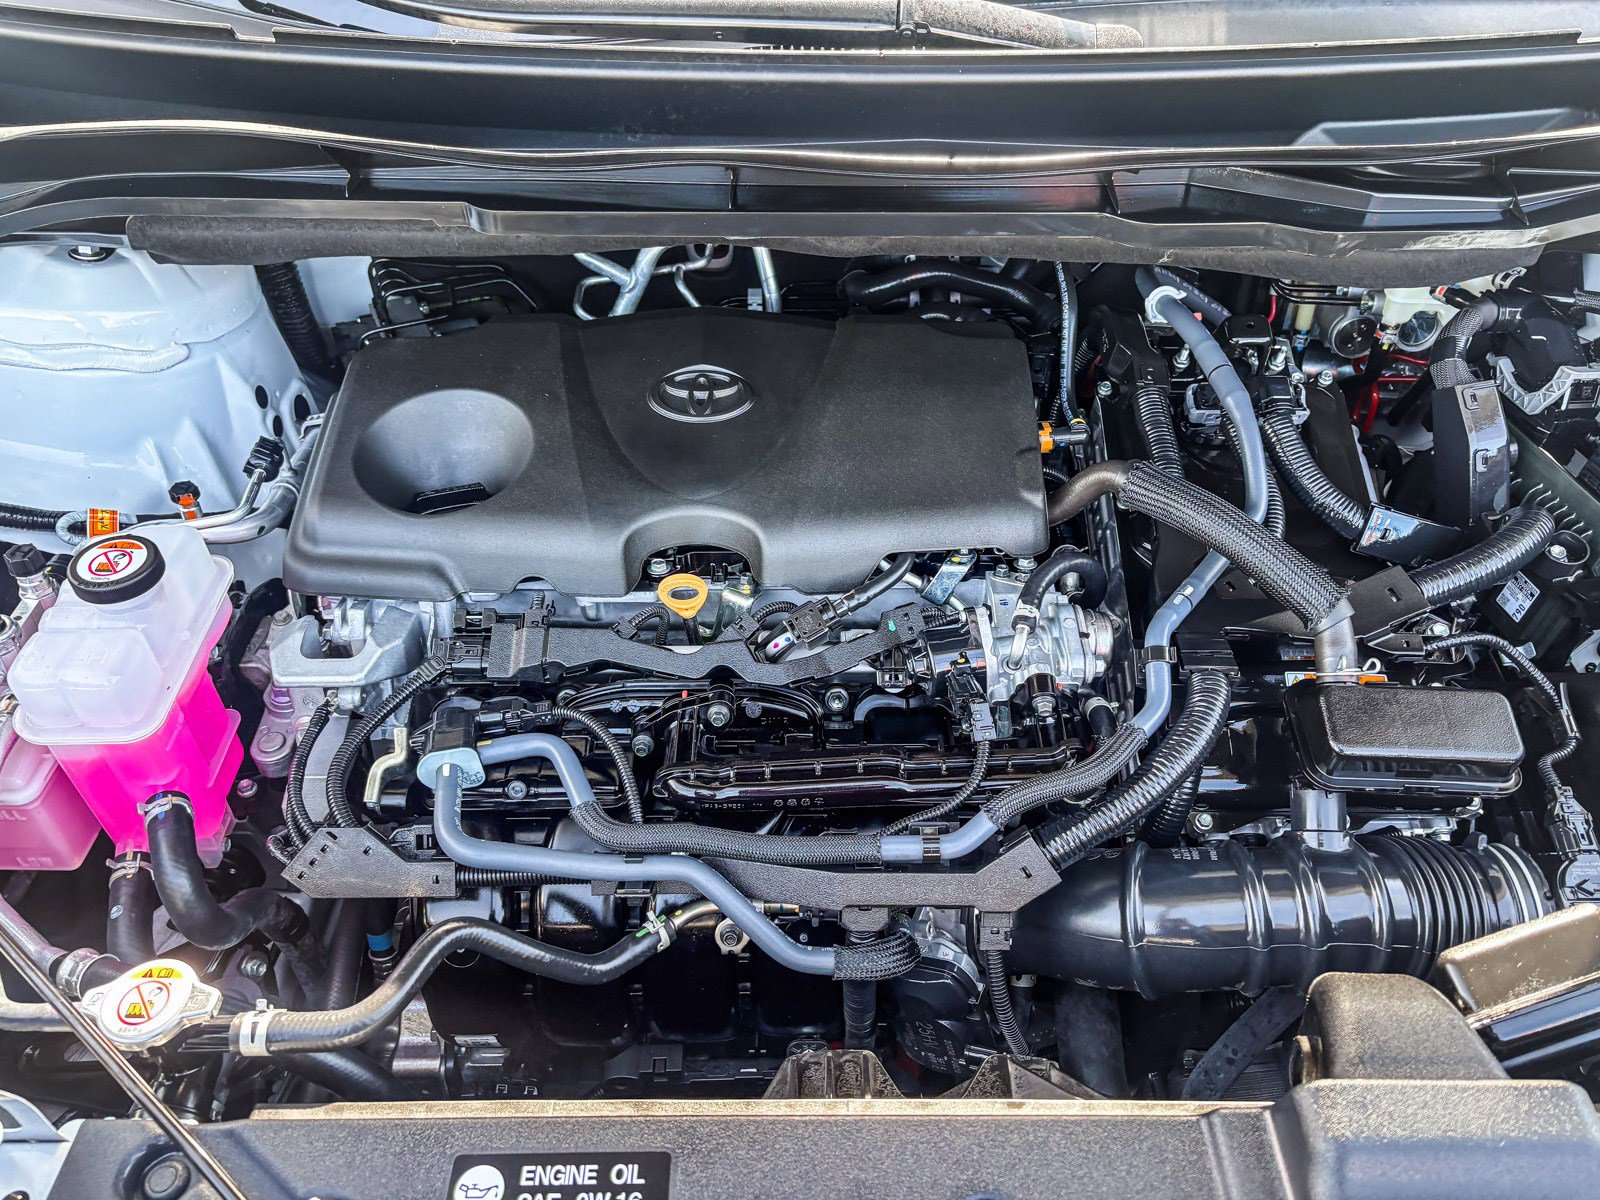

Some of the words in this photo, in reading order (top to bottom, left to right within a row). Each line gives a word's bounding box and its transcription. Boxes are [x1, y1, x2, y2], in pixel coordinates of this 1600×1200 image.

[1511, 603, 1526, 621] 790
[519, 1164, 598, 1186] ENGINE
[610, 1163, 646, 1185] OIL
